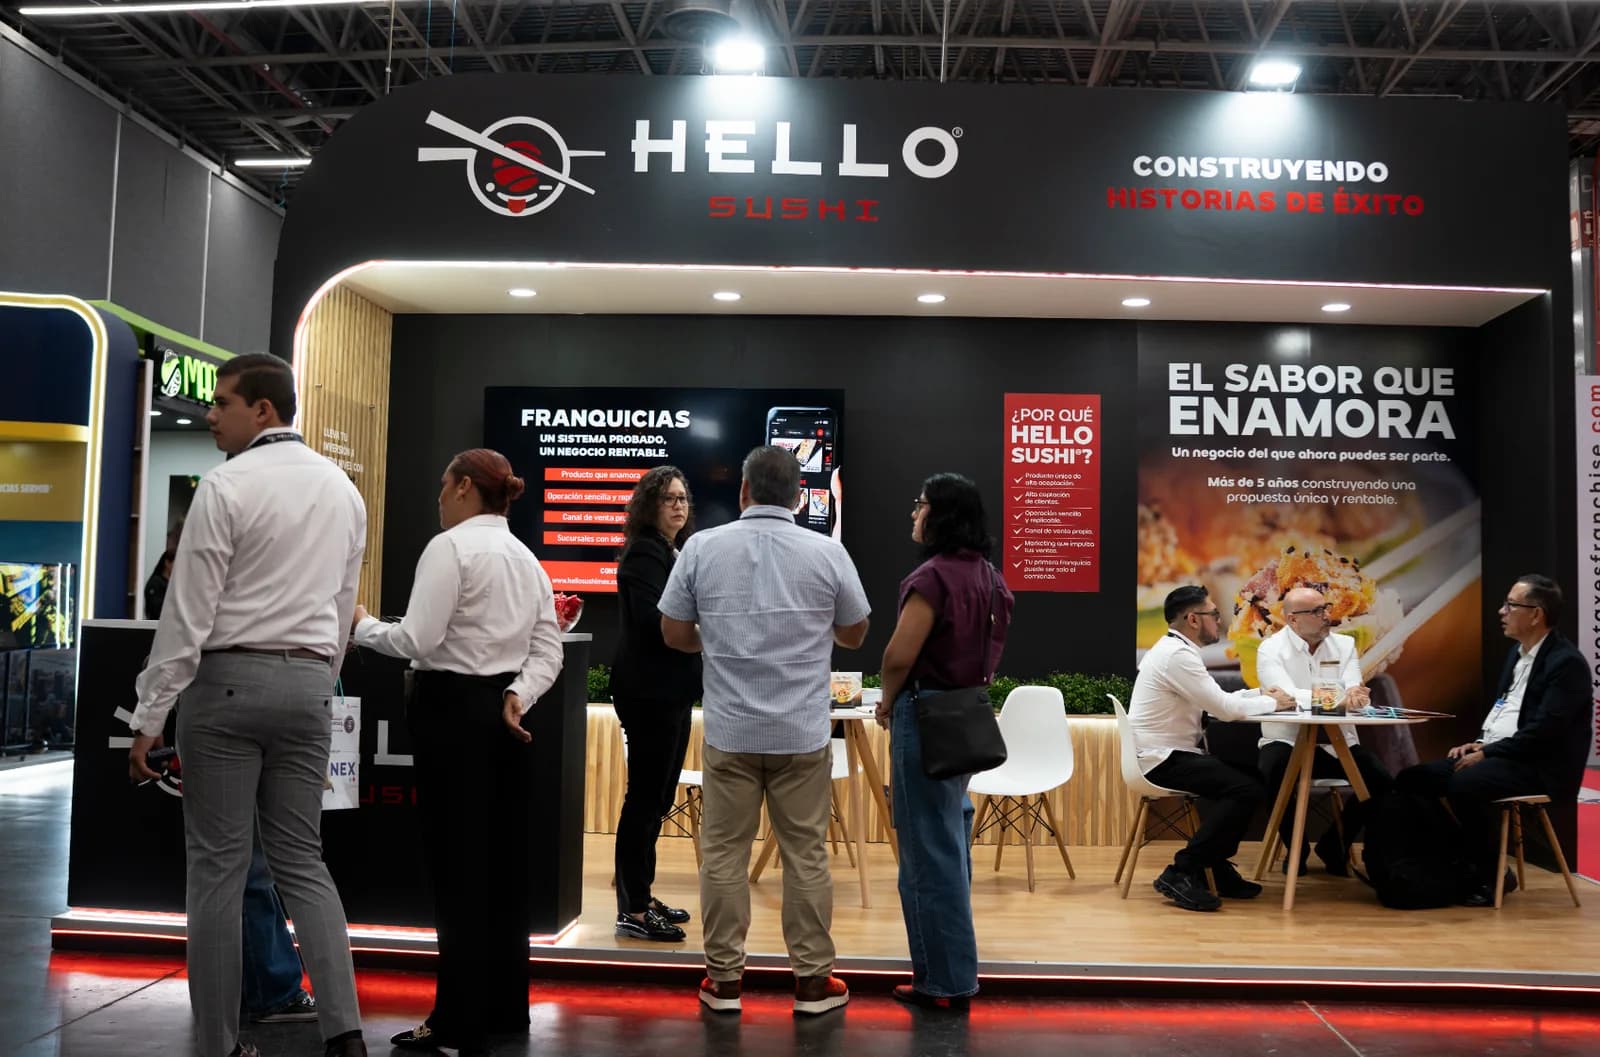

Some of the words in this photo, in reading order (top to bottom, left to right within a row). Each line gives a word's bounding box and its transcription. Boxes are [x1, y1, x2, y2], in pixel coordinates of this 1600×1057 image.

[1132, 155, 1389, 183] CONSTRUYENDO
[708, 196, 880, 222] SUSHI
[1106, 187, 1277, 213] HISTORIAS
[1285, 191, 1326, 214] DE
[1333, 187, 1425, 217] ÉXITO
[1168, 362, 1214, 392] EL
[1224, 363, 1364, 395] SABOR
[1373, 366, 1456, 396] QUE
[521, 408, 691, 428] FRANQUICIAS
[1011, 408, 1055, 423] ¿POR
[1058, 406, 1094, 423] QUÉ
[1168, 395, 1457, 440] ENAMORA
[539, 434, 556, 443] UN
[557, 434, 607, 444] SISTEMA
[1011, 425, 1094, 445] HELLO
[539, 447, 556, 456] UN
[556, 447, 606, 457] NEGOCIO
[608, 447, 669, 458] RENTABLE.
[1171, 447, 1190, 458] Un
[1192, 447, 1245, 461] negocio
[1248, 447, 1268, 459] del
[1270, 449, 1296, 461] que
[1298, 448, 1337, 460] ahora
[1339, 449, 1387, 462] puedes
[1389, 451, 1410, 461] ser
[1412, 451, 1451, 463] parte.
[561, 470, 595, 479] Producto
[594, 471, 608, 480] que
[1207, 476, 1235, 487] Más
[1237, 477, 1254, 487] de
[1256, 478, 1265, 488] 5
[1267, 477, 1299, 489] años
[1301, 479, 1390, 491] construyendo
[1391, 481, 1416, 490] una
[547, 491, 583, 501] Operación
[584, 492, 611, 500] sencilla
[1226, 493, 1291, 504] propuesta
[1293, 492, 1329, 503] única
[1331, 495, 1339, 506] y
[1342, 494, 1398, 505] rentable.
[562, 513, 582, 521] Canal
[557, 534, 594, 542] Sucursales
